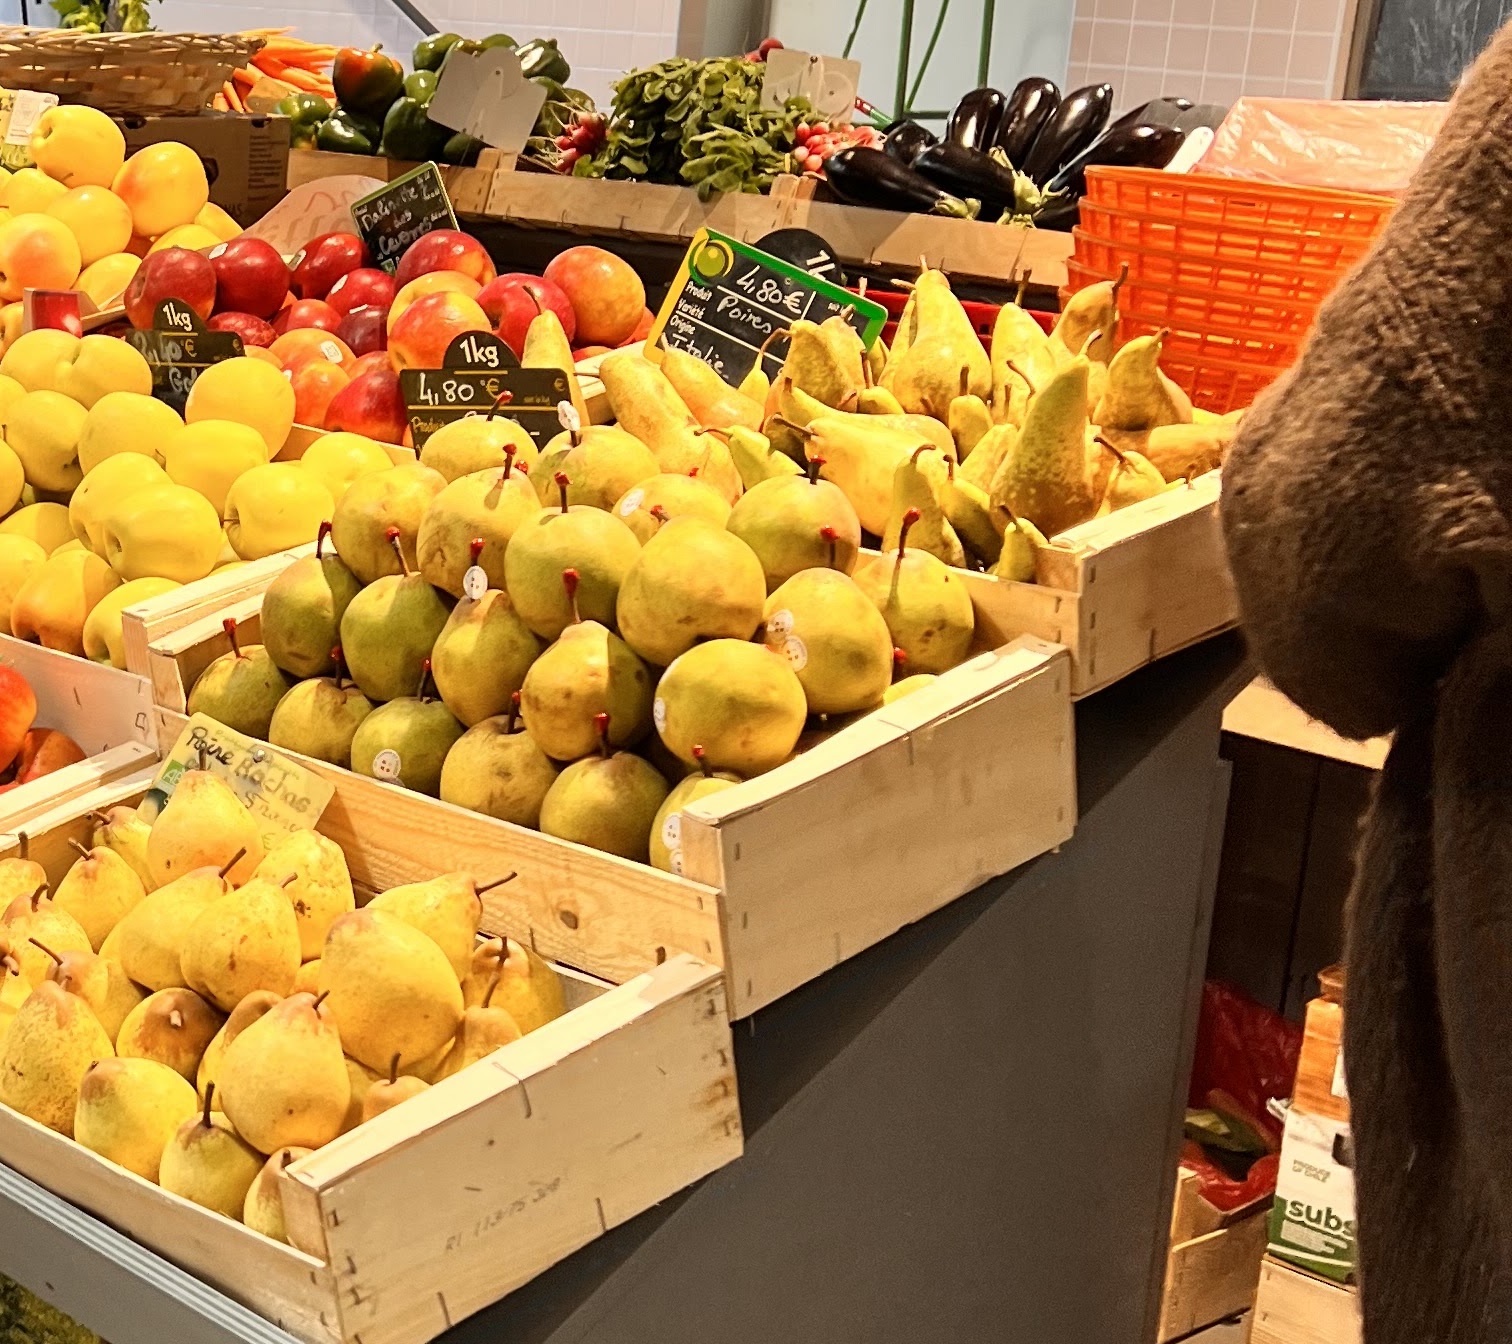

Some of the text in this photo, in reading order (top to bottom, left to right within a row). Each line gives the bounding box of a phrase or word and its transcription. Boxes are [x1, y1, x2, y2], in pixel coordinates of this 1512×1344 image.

[686, 280, 715, 303] Produit
[162, 301, 193, 332] 1kg
[669, 314, 696, 336] Origine
[715, 294, 773, 335] Poires
[459, 335, 500, 368] 1kg
[419, 371, 475, 406] 4,80
